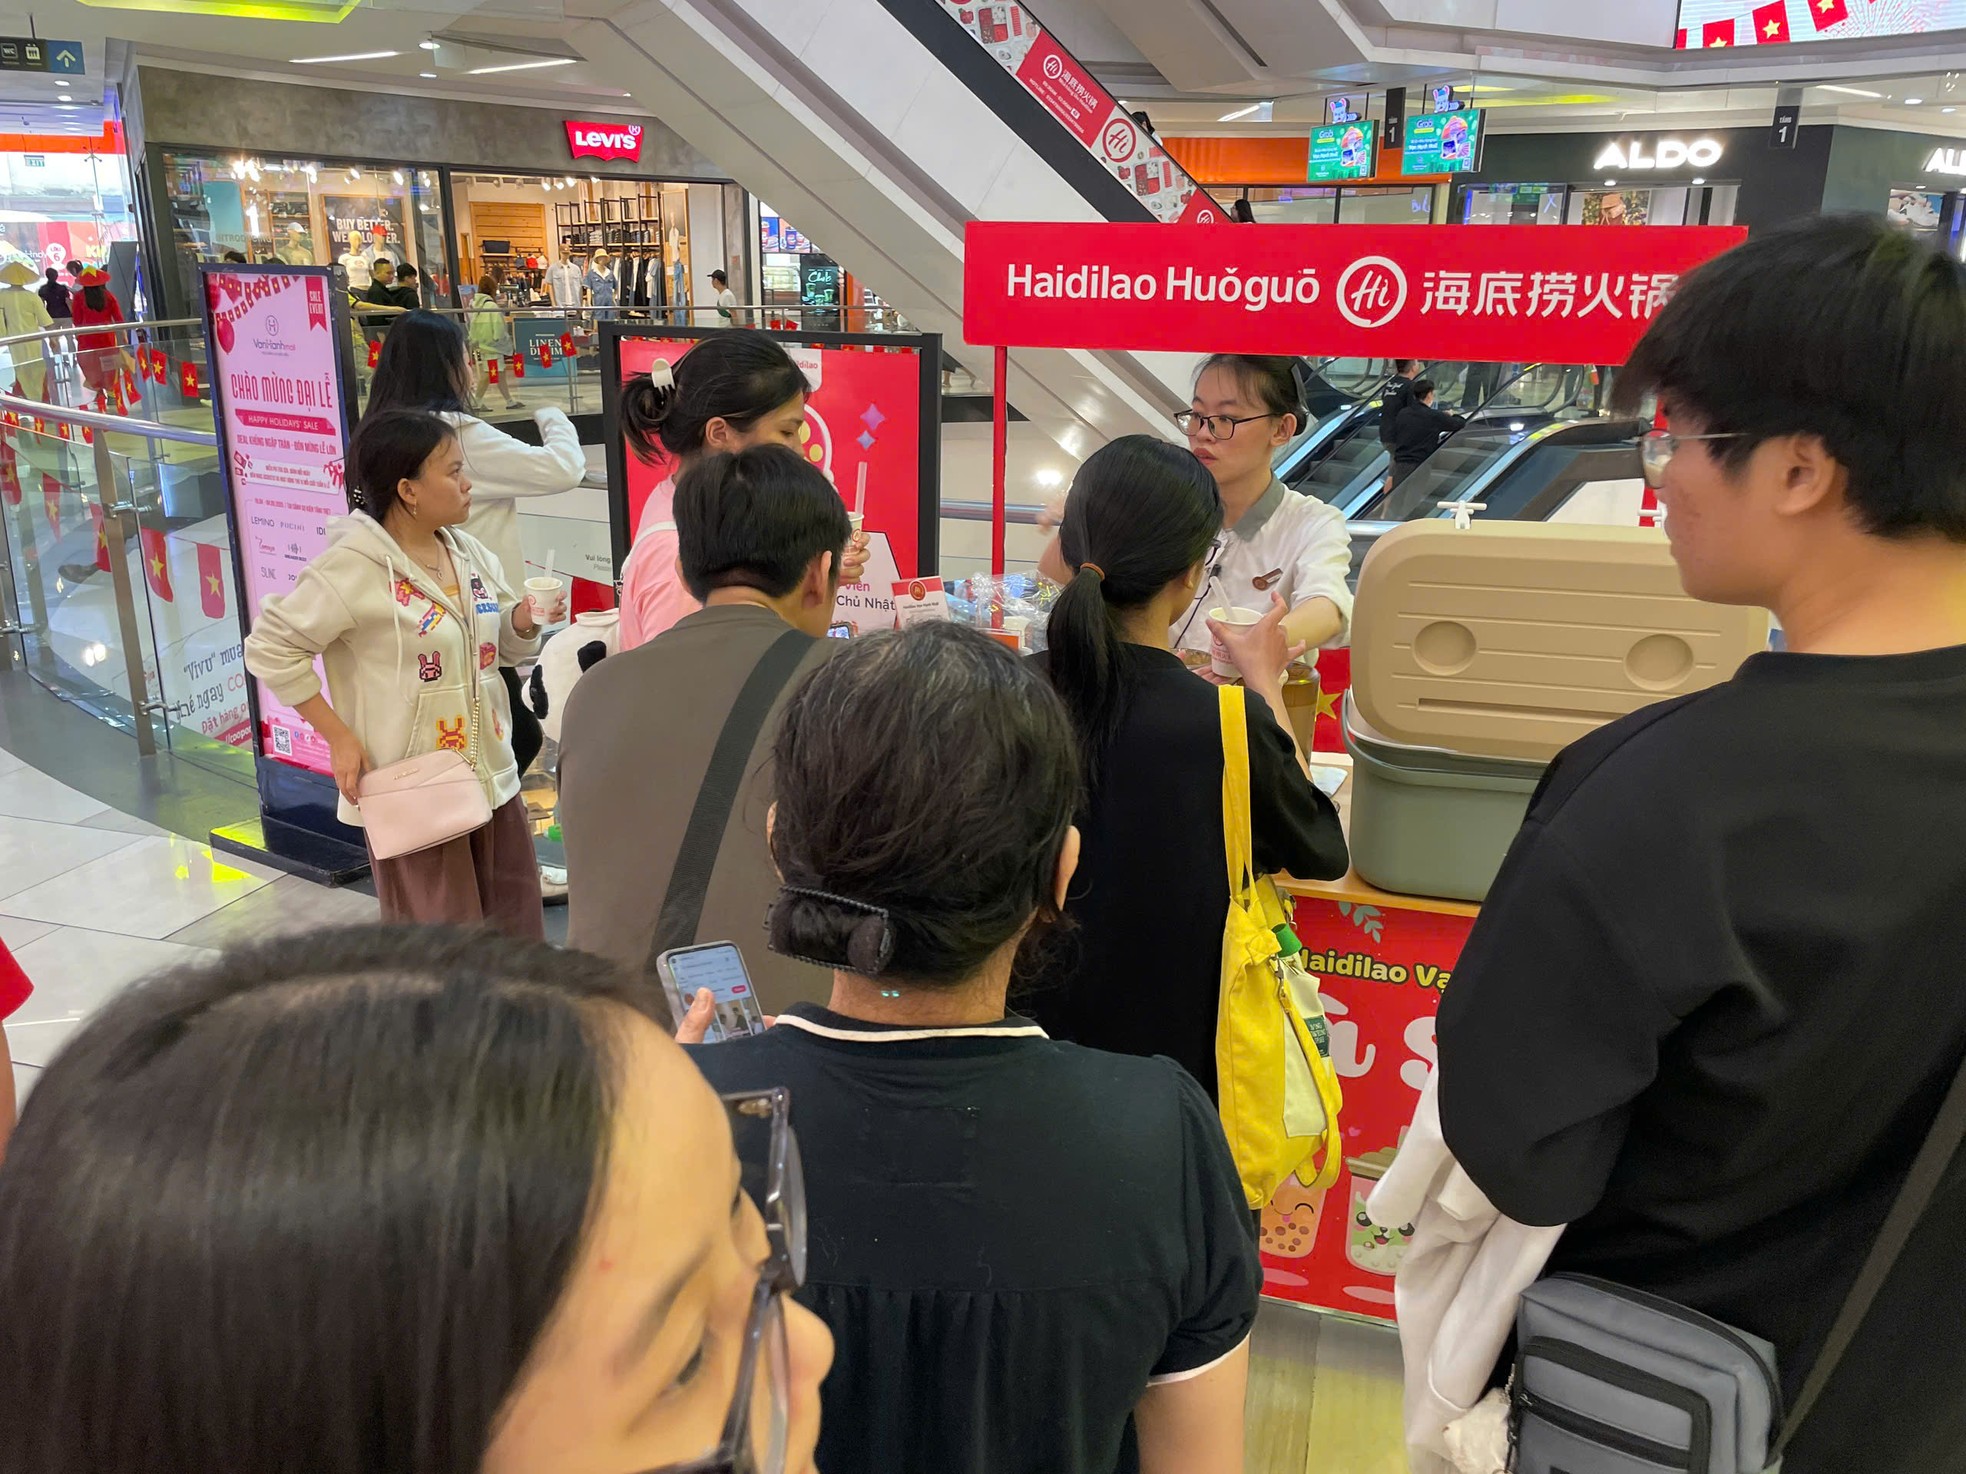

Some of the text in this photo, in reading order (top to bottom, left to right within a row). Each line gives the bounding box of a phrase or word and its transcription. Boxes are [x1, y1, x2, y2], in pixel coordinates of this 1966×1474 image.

[1389, 127, 1397, 143] 1
[1779, 126, 1788, 143] 1
[1594, 140, 1723, 169] ALDO
[1925, 147, 1966, 175] AL
[336, 218, 355, 230] BUY
[1007, 264, 1320, 312] Haidilao Huǒguō
[1420, 271, 1679, 319] 海底捞火锅
[529, 339, 562, 347] LINEN
[231, 370, 333, 412] CHÀO MỪNG ĐẠI LỄ
[248, 415, 268, 425] HAPPY
[303, 422, 319, 431] SALE
[836, 595, 860, 607] Chủ
[865, 597, 896, 612] Nhật
[220, 644, 243, 666] mua
[196, 684, 225, 709] ngay
[1415, 965, 1451, 994] Vạ
